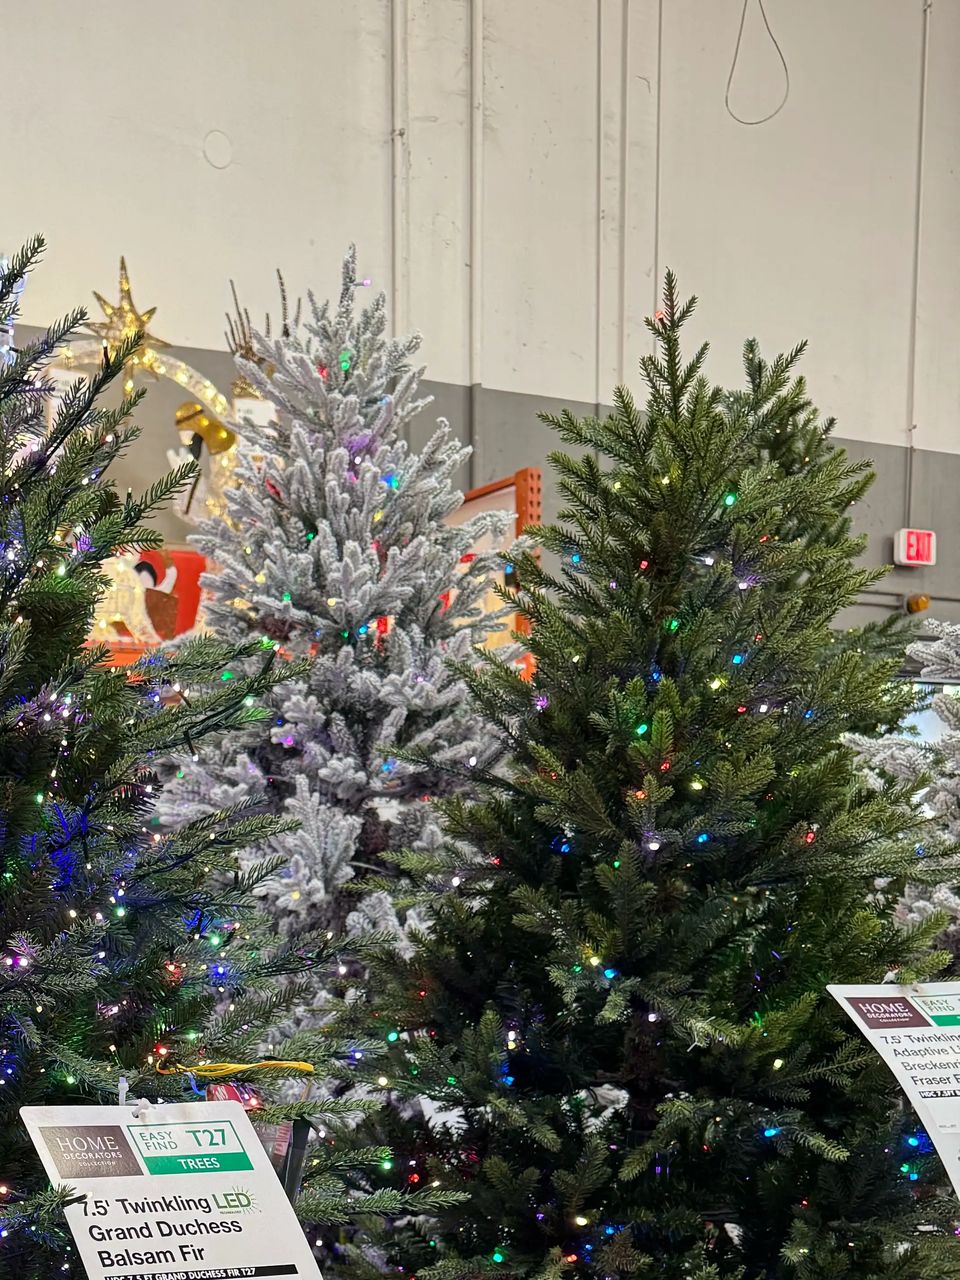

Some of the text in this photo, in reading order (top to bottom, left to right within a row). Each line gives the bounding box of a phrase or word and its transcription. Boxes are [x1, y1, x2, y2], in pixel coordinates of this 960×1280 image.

[907, 531, 932, 562] EXIT
[858, 1003, 909, 1013] HOME
[893, 1046, 950, 1058] Adaptive
[911, 1075, 951, 1086] Fraser
[139, 1131, 173, 1141] EASY
[185, 1128, 227, 1147] T27
[55, 1136, 119, 1151] HOME
[145, 1140, 178, 1151] FIND
[63, 1152, 122, 1160] DECORATORS
[177, 1157, 221, 1169] TREES
[81, 1193, 252, 1217] 7.5' Twinkling LED
[89, 1219, 243, 1242] Grand Duchess
[97, 1244, 205, 1268] Balsam Fir
[188, 1270, 226, 1279] DUCHESS
[227, 1268, 240, 1277] FIR
[241, 1268, 256, 1276] T27
